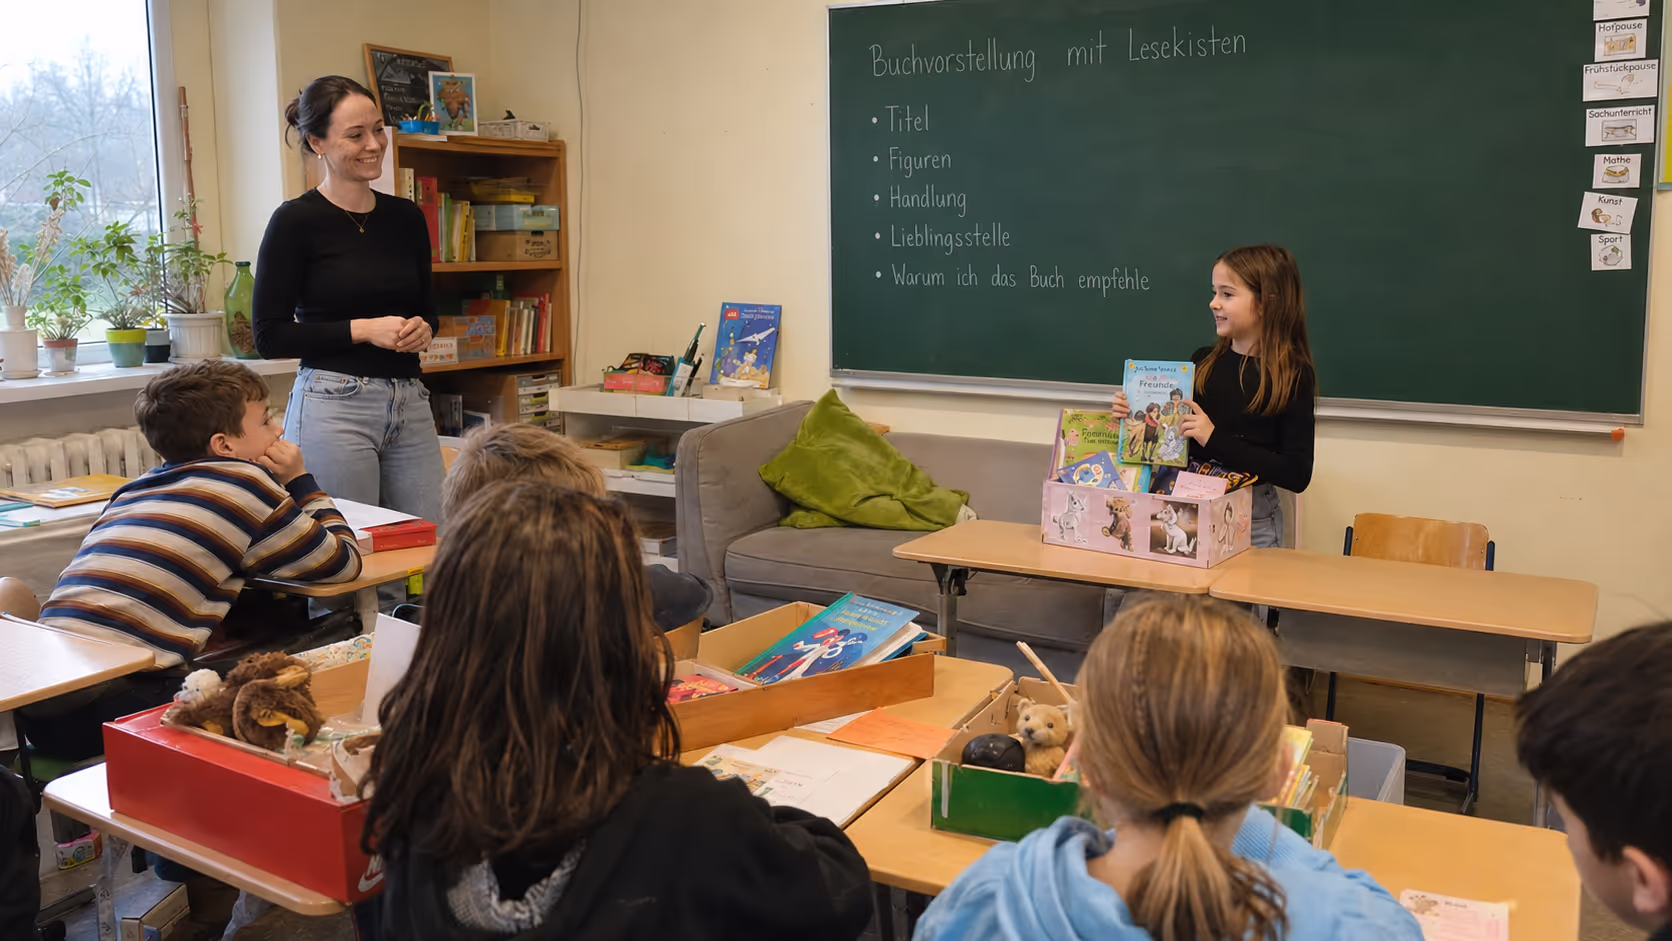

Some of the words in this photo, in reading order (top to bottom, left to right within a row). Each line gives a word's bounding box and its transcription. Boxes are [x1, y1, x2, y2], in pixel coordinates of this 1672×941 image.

[869, 37, 1035, 83] Buchvorstellung
[1067, 30, 1107, 66] mit
[1129, 24, 1246, 61] Lesekisten
[1584, 63, 1656, 74] Frühstückpause
[885, 104, 929, 132] Titel
[1588, 107, 1652, 119] Sachunterricht
[889, 146, 951, 178] Figuren
[1603, 156, 1631, 165] Mathe
[890, 184, 966, 217] Handlung
[1597, 195, 1623, 206] Kunst
[891, 222, 1010, 256] Lieblingsstelle
[1598, 235, 1623, 246] Sport
[891, 263, 945, 286] Warum
[957, 265, 978, 286] ich
[991, 264, 1017, 288] das
[1030, 264, 1065, 288] Buch
[1078, 267, 1150, 298] empfehle
[1139, 380, 1174, 389] Freunde
